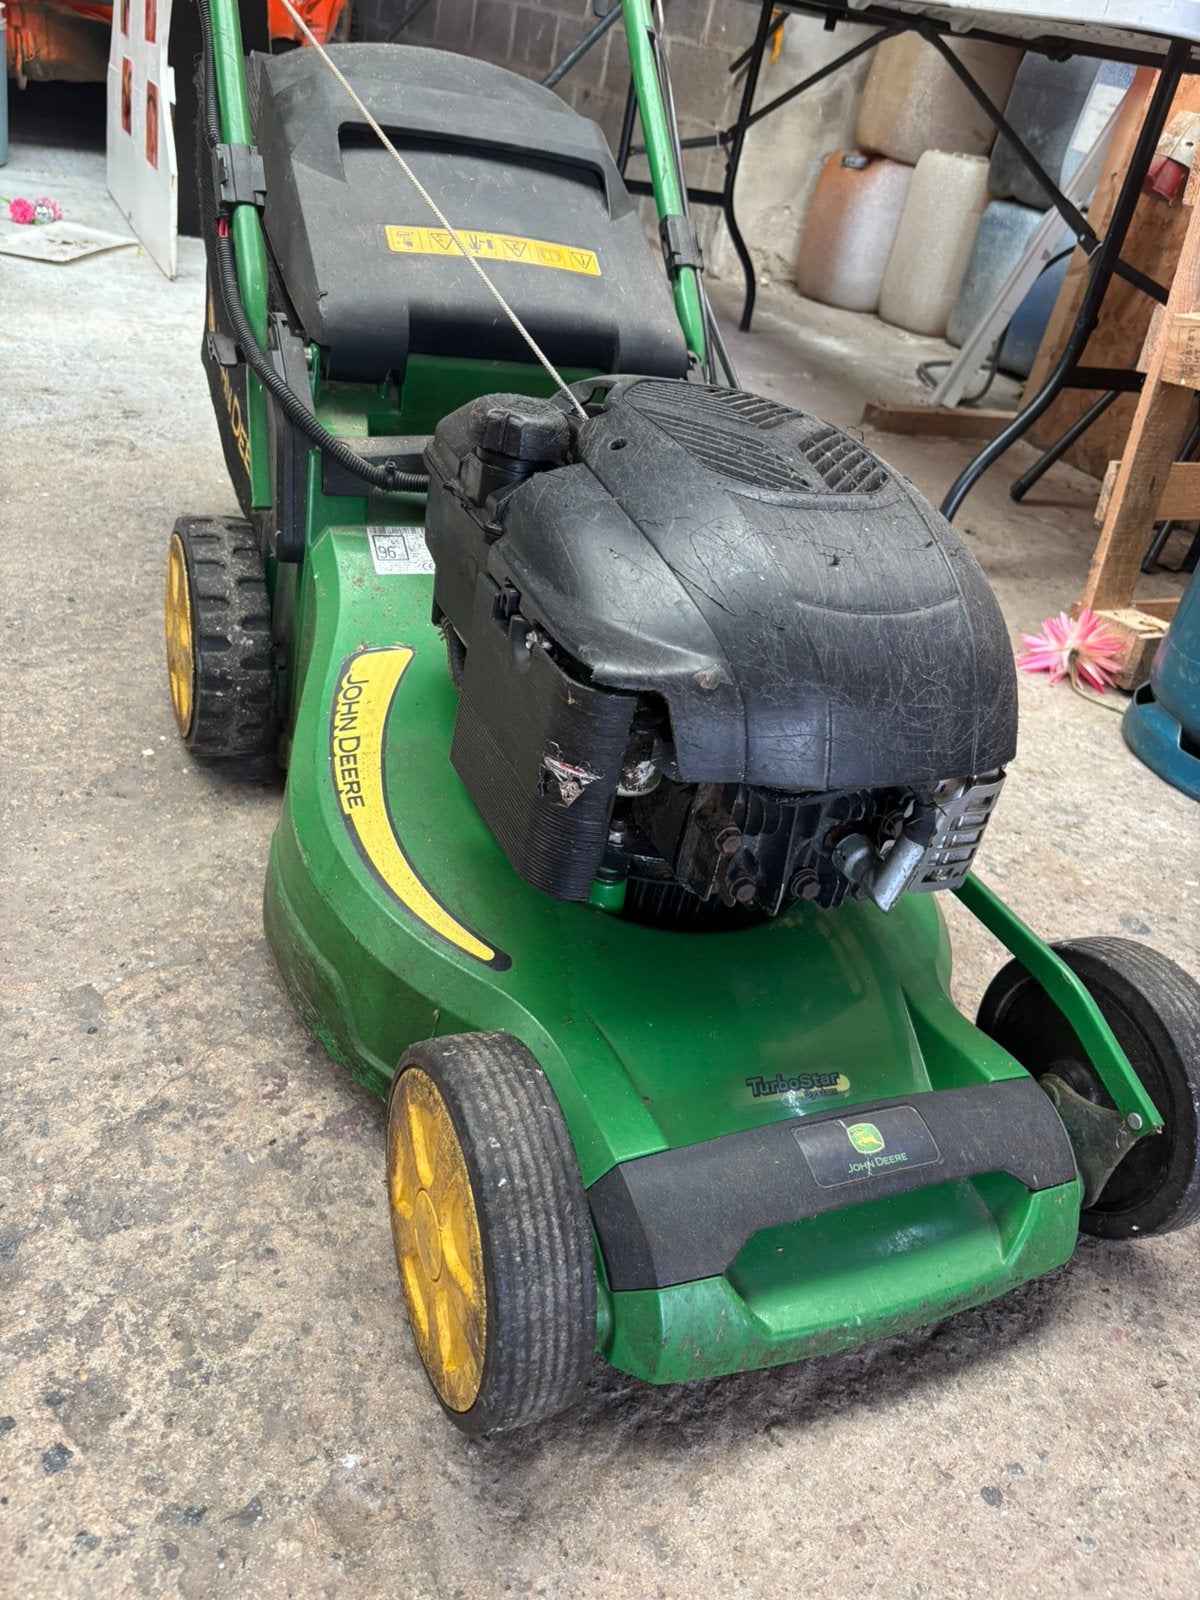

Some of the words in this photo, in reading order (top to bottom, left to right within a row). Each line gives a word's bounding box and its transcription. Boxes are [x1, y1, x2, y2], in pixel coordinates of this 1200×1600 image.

[378, 546, 397, 558] 96
[339, 674, 369, 732] JOHN
[338, 736, 366, 809] DEERE
[746, 1072, 841, 1097] TurboStar
[848, 1160, 875, 1174] JOHN
[877, 1153, 909, 1167] DEERE
